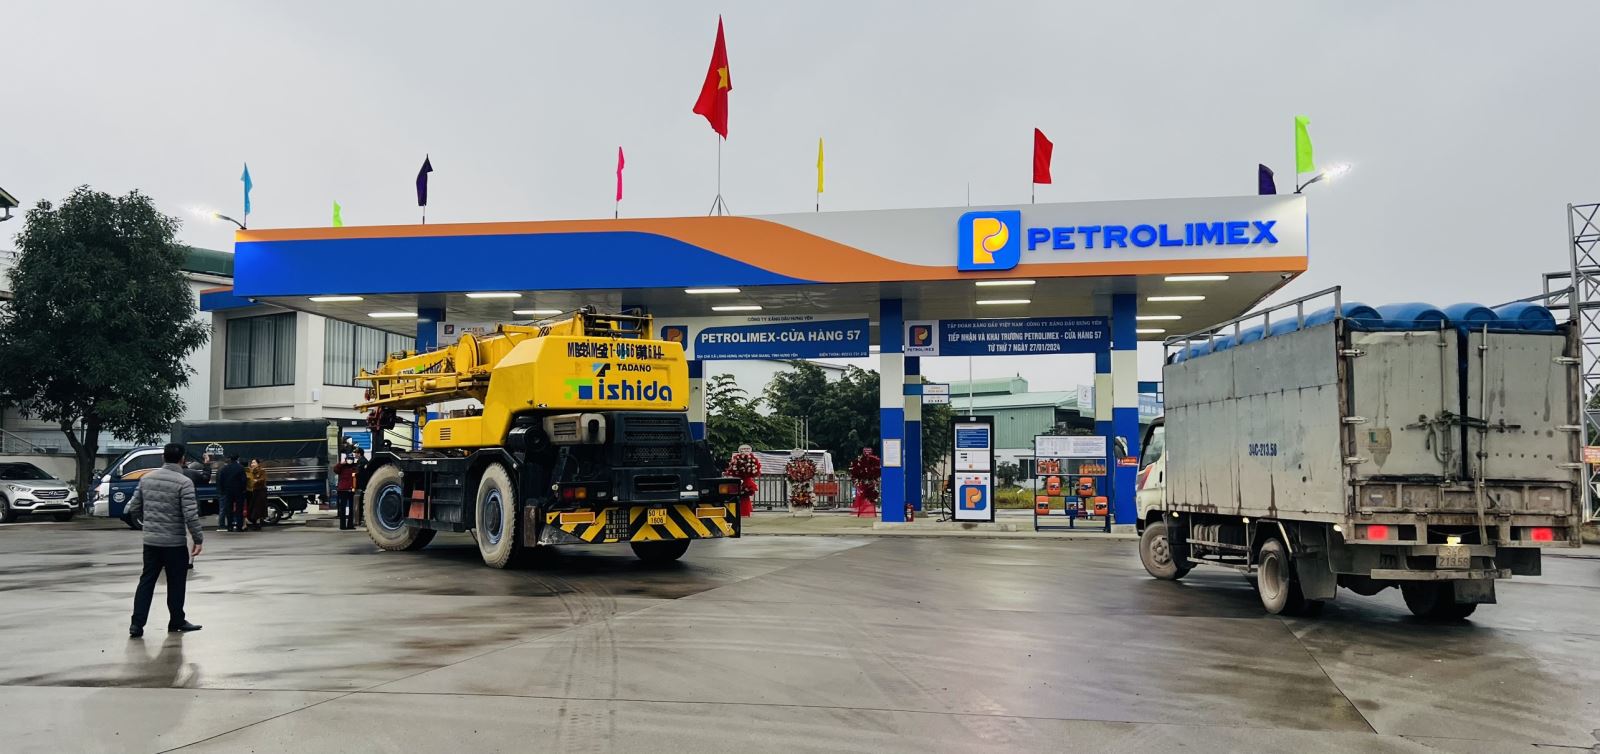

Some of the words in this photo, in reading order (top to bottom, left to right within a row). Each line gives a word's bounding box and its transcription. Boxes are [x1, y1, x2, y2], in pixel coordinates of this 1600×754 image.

[1027, 220, 1279, 251] PETROLIMEX
[808, 328, 844, 342] HÀNG
[846, 329, 861, 341] 57
[947, 332, 960, 342] TIẾP
[961, 332, 977, 343] NHẬN
[986, 332, 1000, 342] KHAI
[1024, 331, 1060, 341] PETROLIMEX
[1064, 328, 1076, 340] CỬA
[1094, 330, 1102, 339] 57
[1012, 342, 1028, 351] NGÀY
[1029, 343, 1061, 352] 27/01/2024
[616, 364, 652, 372] TADANO
[598, 378, 672, 402] ishida
[1248, 443, 1278, 457] 34C-213.58
